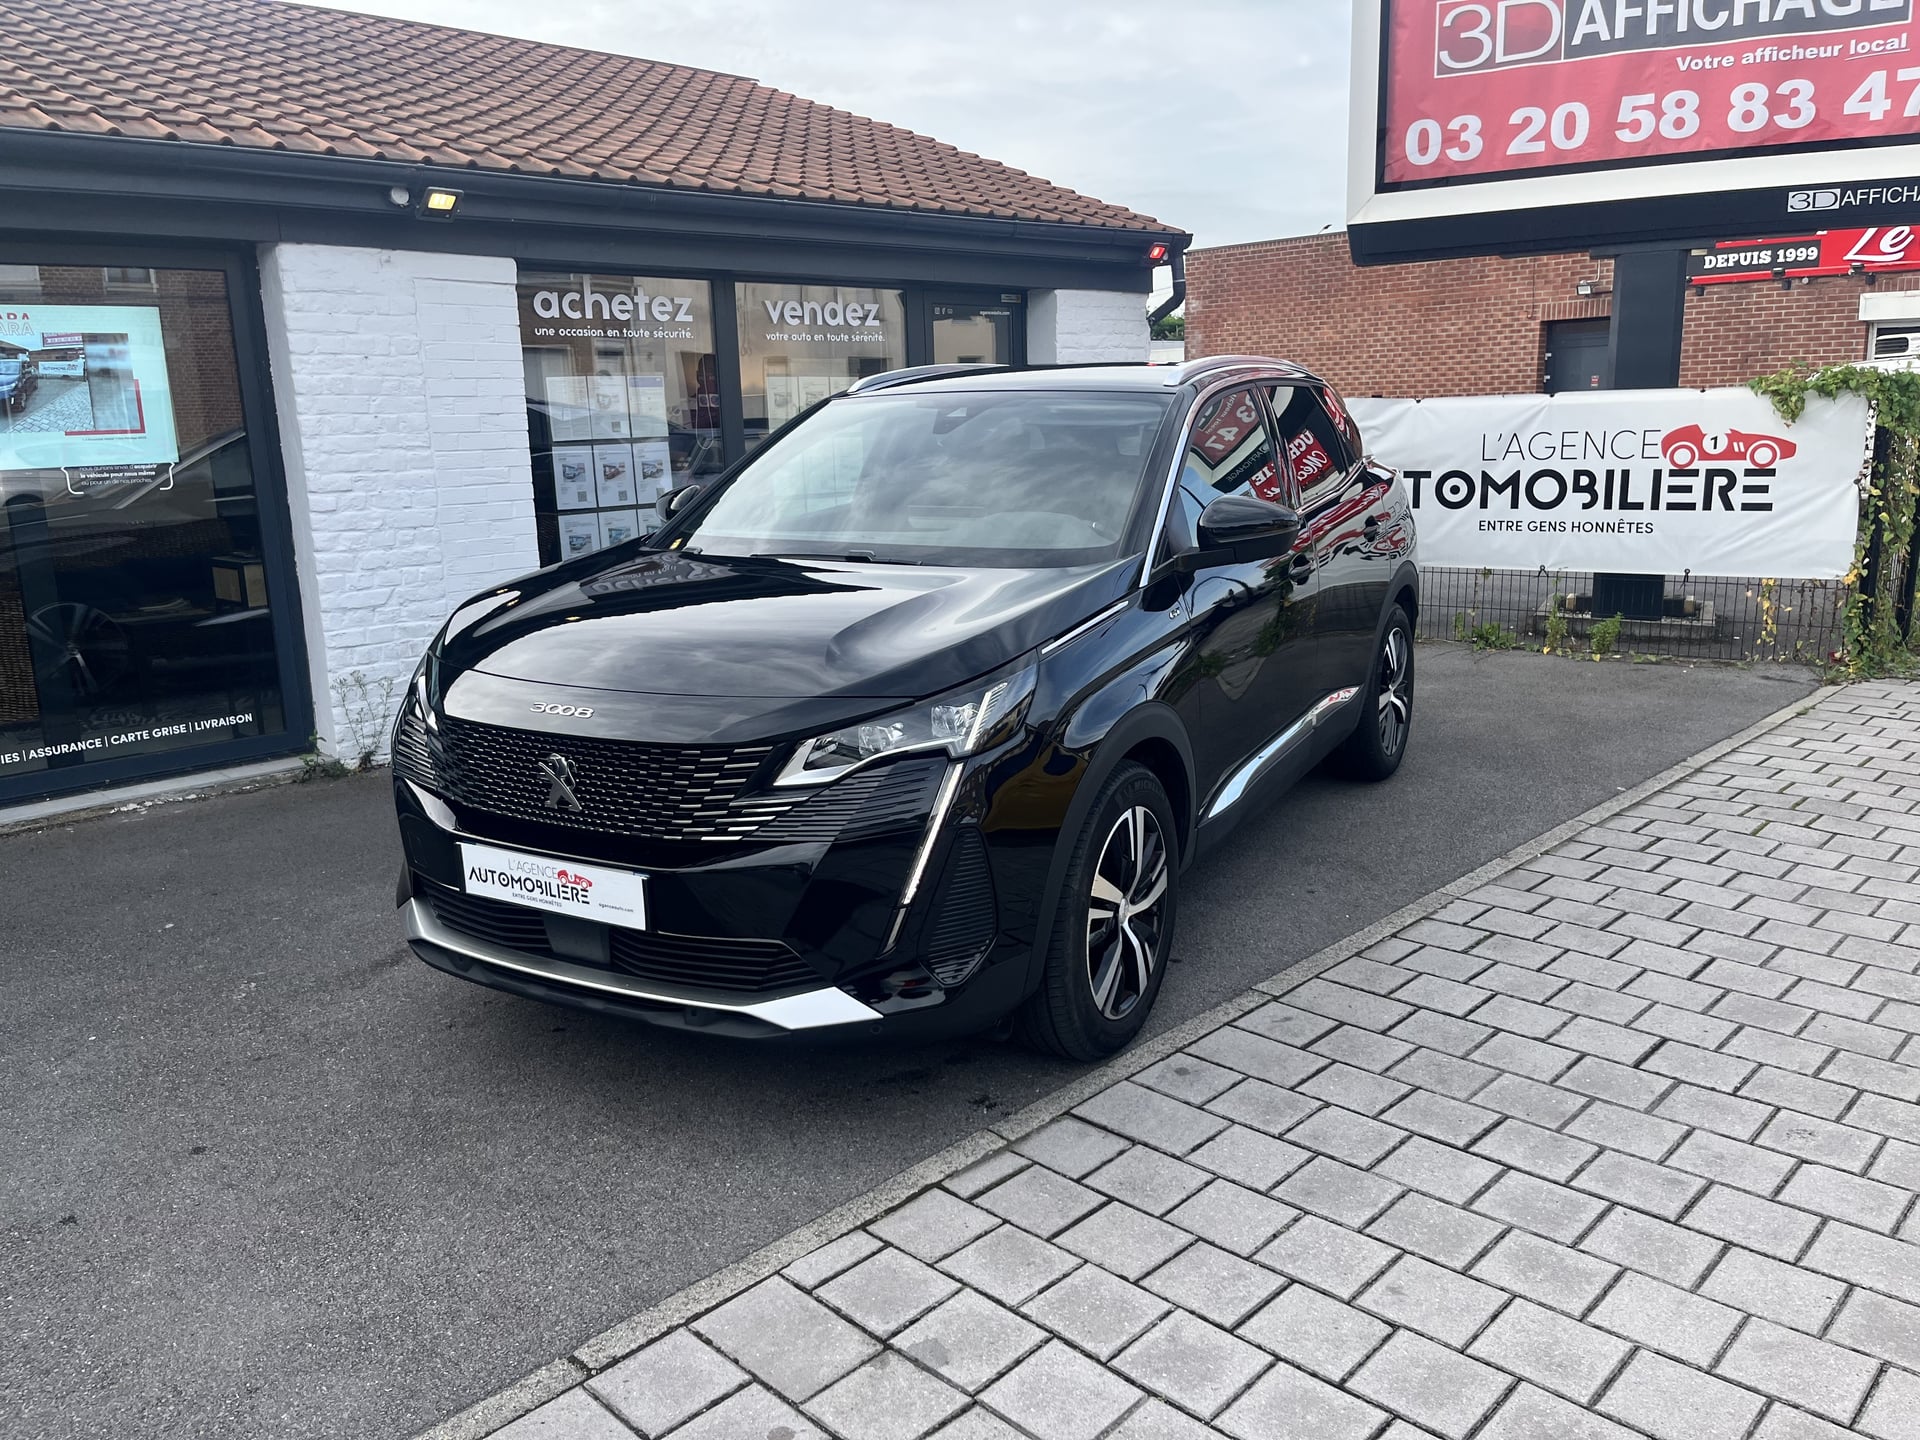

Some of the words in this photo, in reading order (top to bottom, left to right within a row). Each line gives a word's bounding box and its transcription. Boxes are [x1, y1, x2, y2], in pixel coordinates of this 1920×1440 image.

[1439, 0, 1562, 69] 3D
[1571, 0, 1904, 46] AFFICH
[1676, 56, 1735, 72] Votre
[1741, 43, 1844, 65] afficheur
[1849, 32, 1908, 55] local
[1405, 115, 1484, 166] 03
[1506, 101, 1590, 156] 20
[1614, 89, 1700, 143] 58
[1727, 78, 1817, 133] 83
[1843, 66, 1920, 121] 47
[1789, 190, 1839, 211] 3D
[1841, 185, 1920, 206] AFFICH
[1703, 249, 1772, 269] DEPUIS
[1776, 246, 1819, 263] 1999
[1843, 225, 1915, 262] Le
[533, 278, 694, 322] achetez
[765, 288, 880, 327] vendez
[535, 327, 556, 337] une
[558, 325, 604, 338] occasion
[607, 329, 620, 338] en
[622, 327, 650, 339] toute
[653, 326, 694, 339] sécurité.
[766, 331, 789, 341] votre
[791, 331, 812, 342] auto
[827, 332, 849, 342] toute
[851, 331, 886, 342] sérénité.
[1482, 430, 1662, 462] L'AGENCE
[1403, 468, 1777, 512] TOMOBILIERE
[1478, 520, 1523, 532] ENTRE
[1527, 520, 1567, 533] GENS
[1571, 518, 1654, 534] HONNÊTES
[529, 701, 595, 719] 3008
[0, 752, 20, 765] IES
[28, 738, 103, 760] ASSURANCE
[110, 729, 150, 745] CARTE
[152, 723, 187, 738] GRISE
[194, 713, 253, 731] LIVRAISON
[469, 866, 590, 905] AUTOMOBILIERE
[508, 857, 558, 880] L'AGENCE
